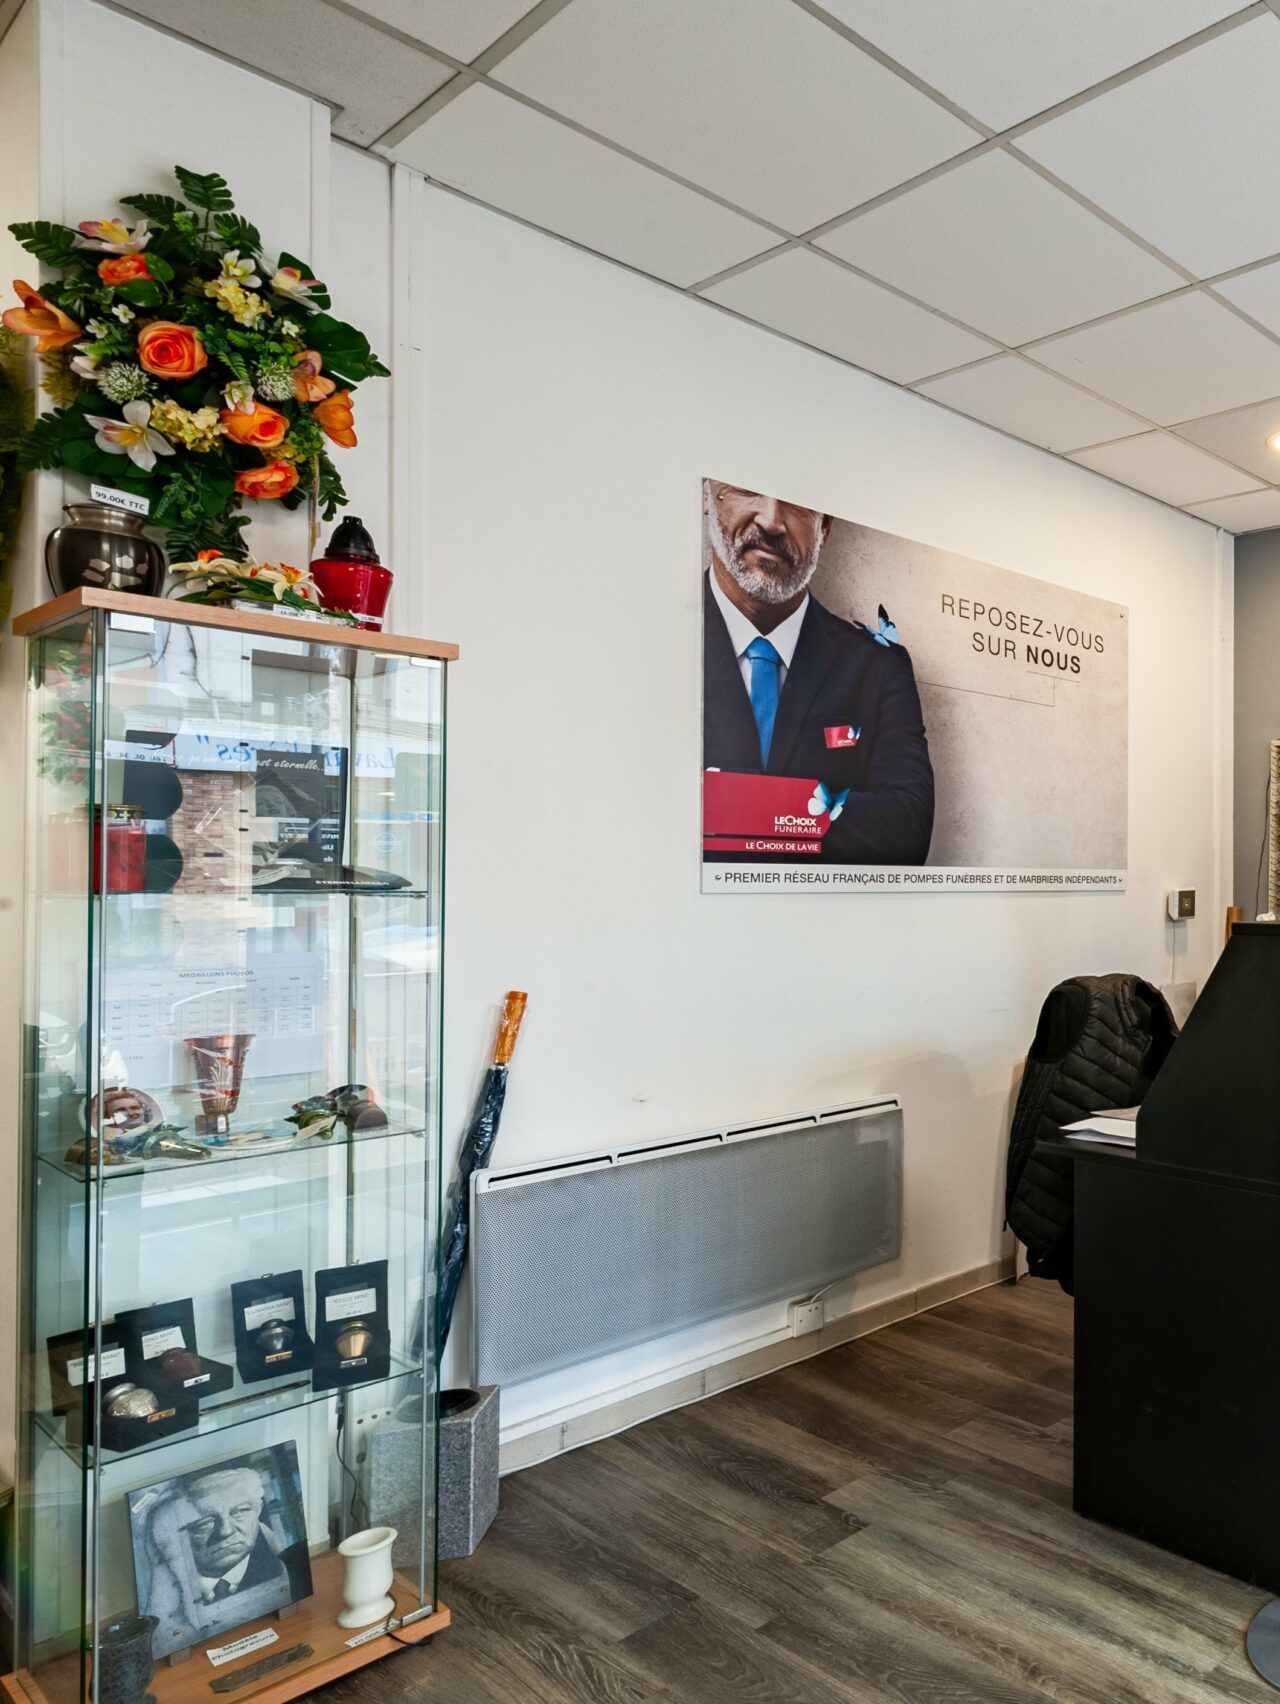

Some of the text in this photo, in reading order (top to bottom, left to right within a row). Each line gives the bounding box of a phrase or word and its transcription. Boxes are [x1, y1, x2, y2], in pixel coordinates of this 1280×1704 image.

[941, 593, 1105, 654] REPOSEZ-VOUS
[972, 631, 1081, 675] SUR NOUS
[755, 841, 784, 850] CHOIX
[785, 842, 796, 851] DE
[797, 843, 807, 851] LA
[807, 843, 819, 851] VIE
[724, 872, 781, 884] PREMIER
[784, 870, 830, 884] RÉSEAU
[832, 873, 885, 887] FRANÇAIS
[887, 873, 901, 884] DE
[903, 873, 944, 884] POMPES
[994, 874, 1005, 884] ET
[1006, 874, 1017, 884] DE
[1018, 875, 1064, 885] MARBRIERS
